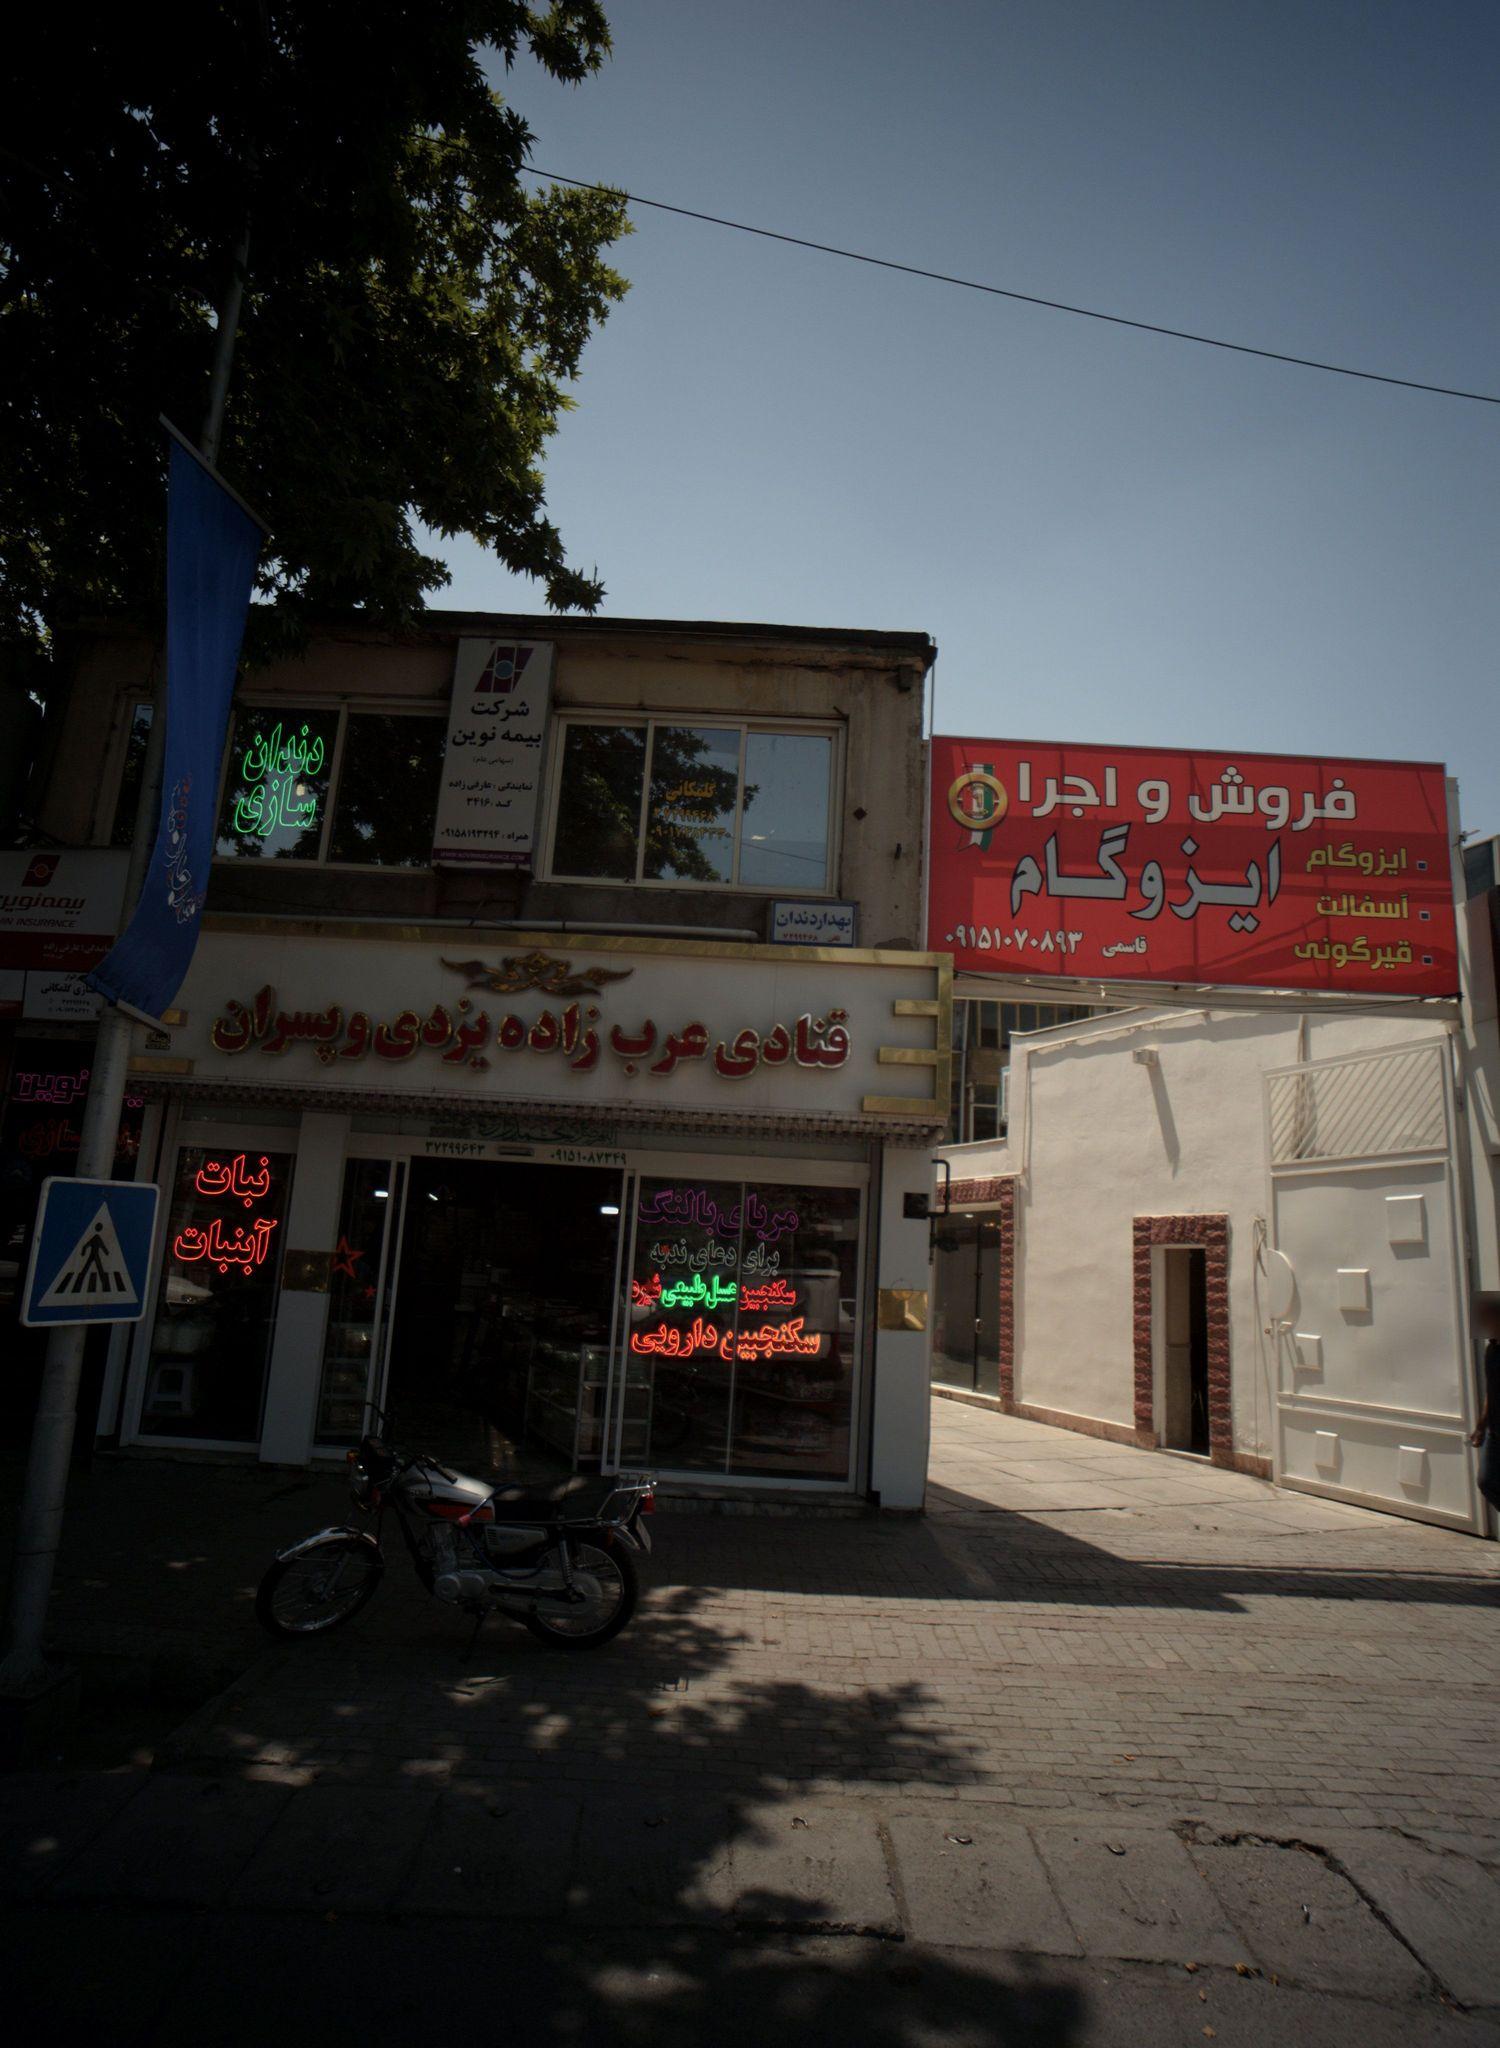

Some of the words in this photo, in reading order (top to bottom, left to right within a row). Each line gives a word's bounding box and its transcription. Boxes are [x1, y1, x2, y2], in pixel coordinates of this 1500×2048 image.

[471, 700, 530, 721] شرکت
[243, 723, 324, 781] دندان
[452, 726, 496, 747] نوین
[501, 729, 541, 748] بیمه
[235, 776, 316, 836] سازی
[1018, 761, 1117, 818] اجرا
[1137, 777, 1170, 823] و
[1189, 765, 1357, 831] فروش
[1010, 822, 1282, 933] ایزوگام
[1306, 842, 1407, 876] ایزوگام
[17, 918, 77, 928] INSURANCE
[945, 924, 1083, 954] ۰۹۱۵۱۰۷۰۸۹۳
[1101, 935, 1147, 957] قاسمی
[1294, 936, 1413, 970] قیرگونی
[211, 984, 342, 1065] پسران
[374, 998, 490, 1072] یزدی
[497, 1001, 601, 1072] زاده
[610, 1017, 710, 1076] عرب
[714, 1009, 851, 1079] قنادی
[195, 1154, 270, 1208] نبات
[174, 1218, 278, 1276] آبنبات
[742, 1242, 780, 1277] برای
[631, 1317, 718, 1358] دارویی
[720, 1316, 821, 1361] سکنجبین
